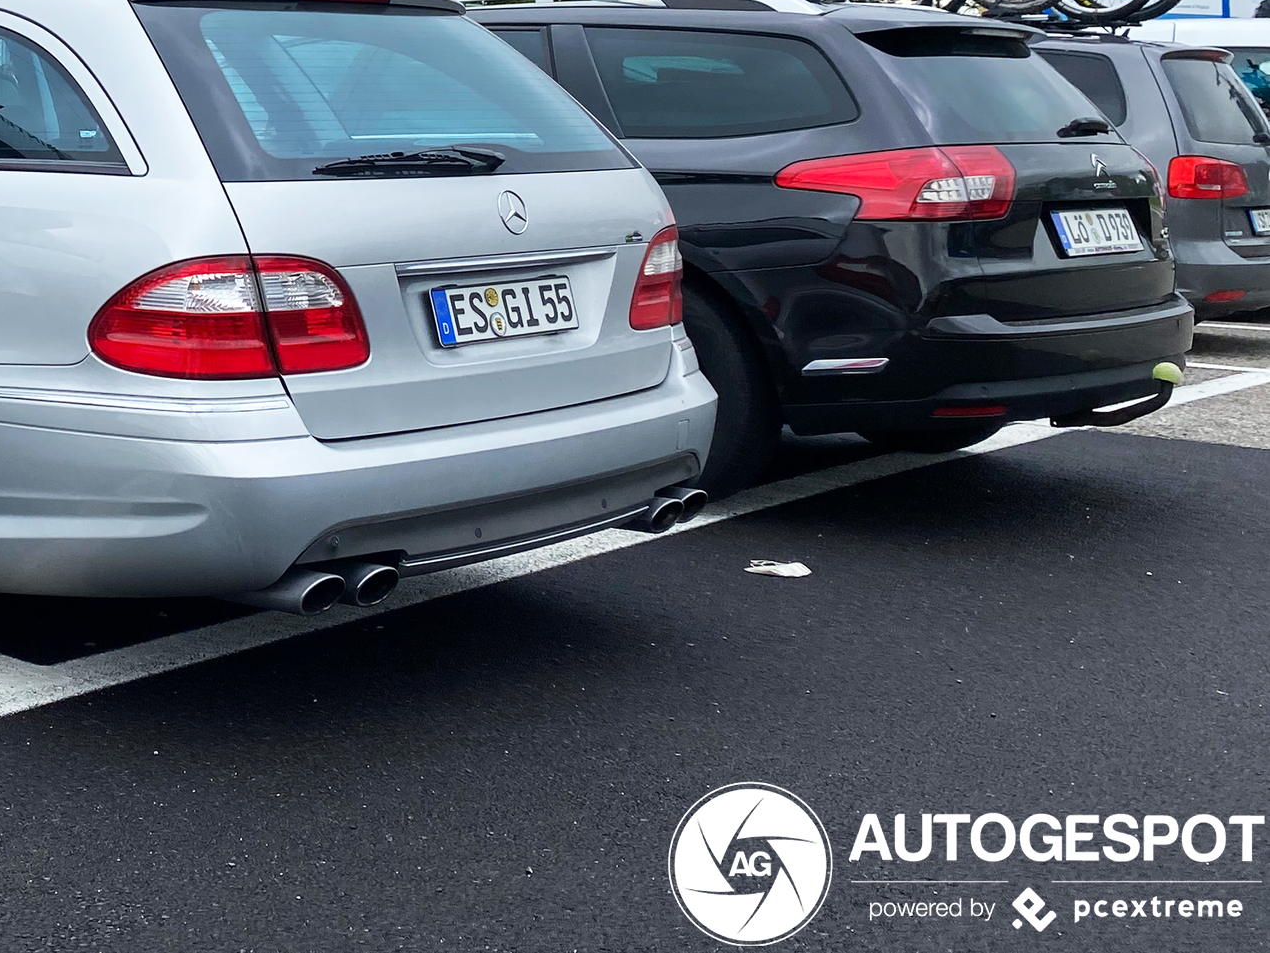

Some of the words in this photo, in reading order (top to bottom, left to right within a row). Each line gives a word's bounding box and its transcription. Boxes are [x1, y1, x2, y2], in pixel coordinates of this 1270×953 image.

[449, 292, 489, 336] ES
[501, 287, 540, 329] GI
[538, 282, 573, 324] 55
[442, 322, 450, 335] D
